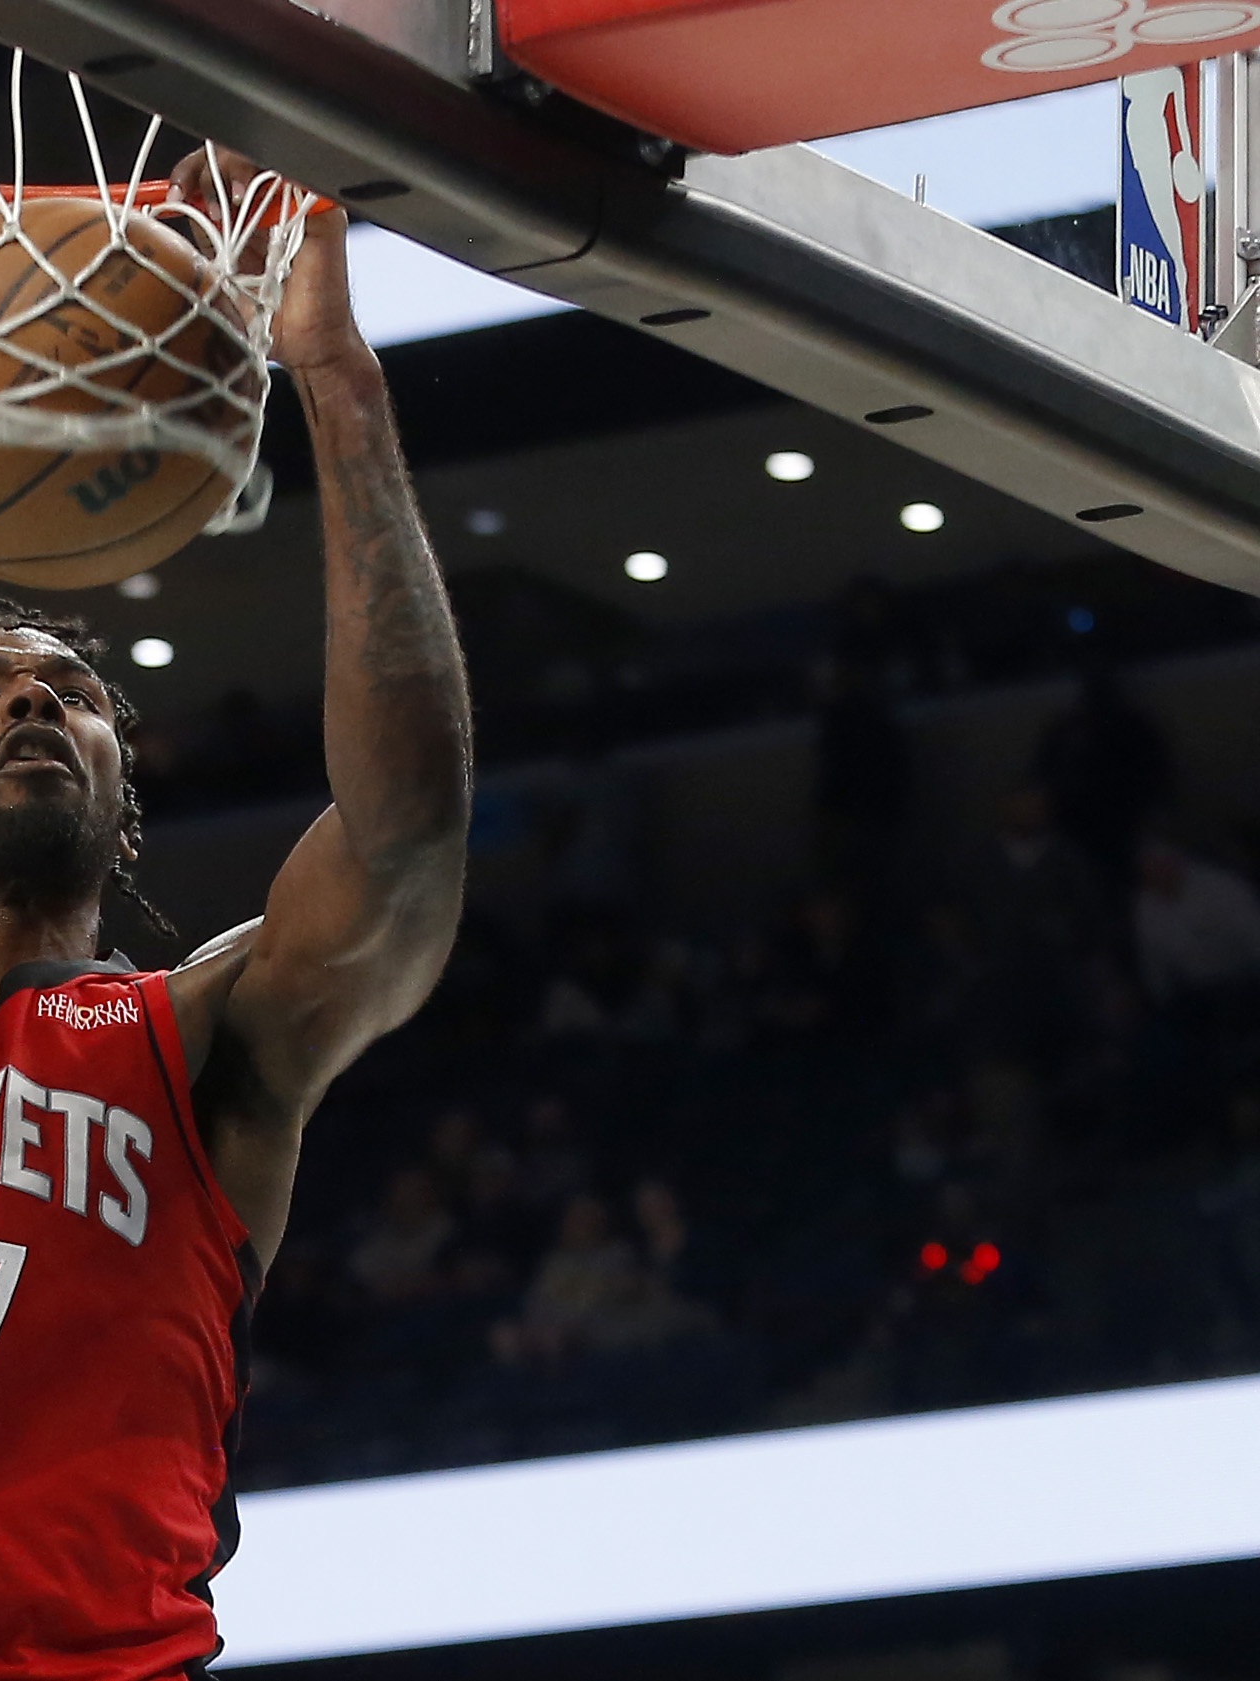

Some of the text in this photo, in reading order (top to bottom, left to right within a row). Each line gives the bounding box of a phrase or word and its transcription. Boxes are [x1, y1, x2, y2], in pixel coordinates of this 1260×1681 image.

[1130, 243, 1171, 315] NBA
[38, 993, 138, 1021] MEMORIAL
[38, 1004, 138, 1030] HERMANN
